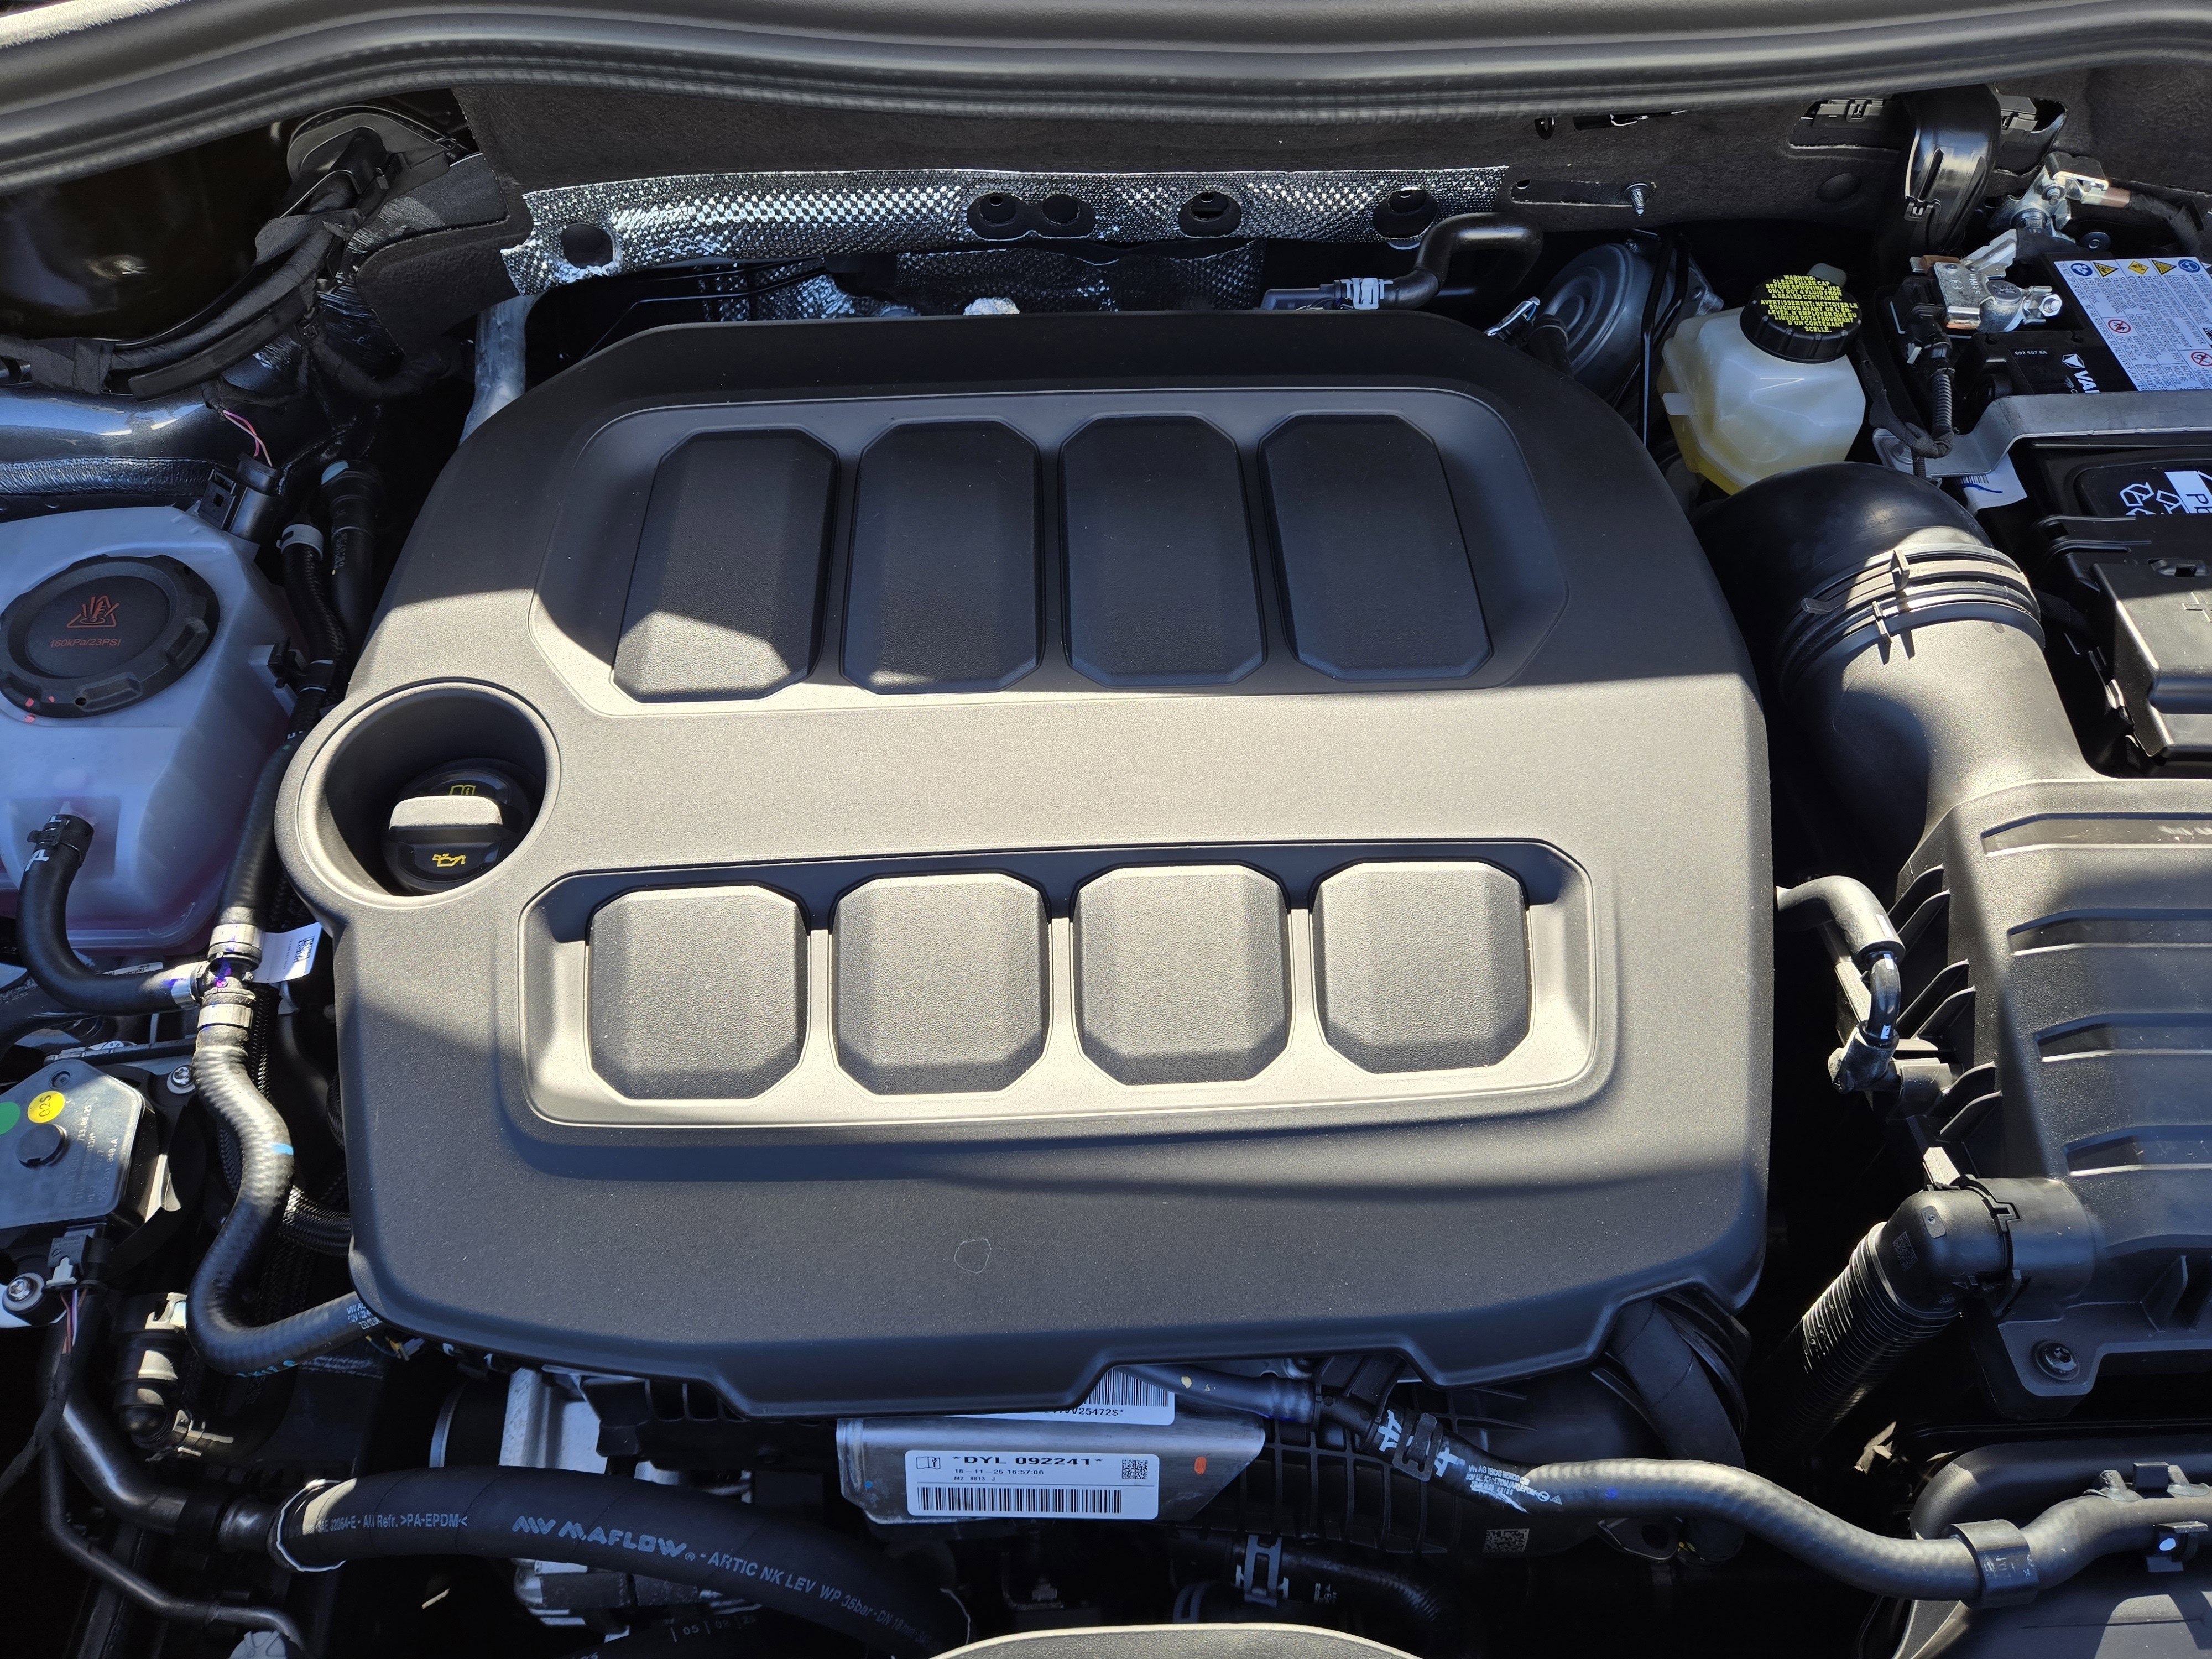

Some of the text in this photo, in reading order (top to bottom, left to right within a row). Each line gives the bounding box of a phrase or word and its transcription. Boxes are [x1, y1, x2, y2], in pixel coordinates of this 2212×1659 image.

[2132, 336, 2143, 345] KEEP
[2160, 375, 2173, 386] HORS
[2180, 366, 2197, 381] BATTERY
[2131, 375, 2147, 390] BATTER
[50, 638, 122, 648] 160kPa/23PSI
[377, 1514, 399, 1528] Refr.
[707, 1551, 759, 1577] ARTIC
[759, 1565, 785, 1586] NK
[785, 1573, 817, 1594] LEV
[818, 1584, 843, 1603] WP
